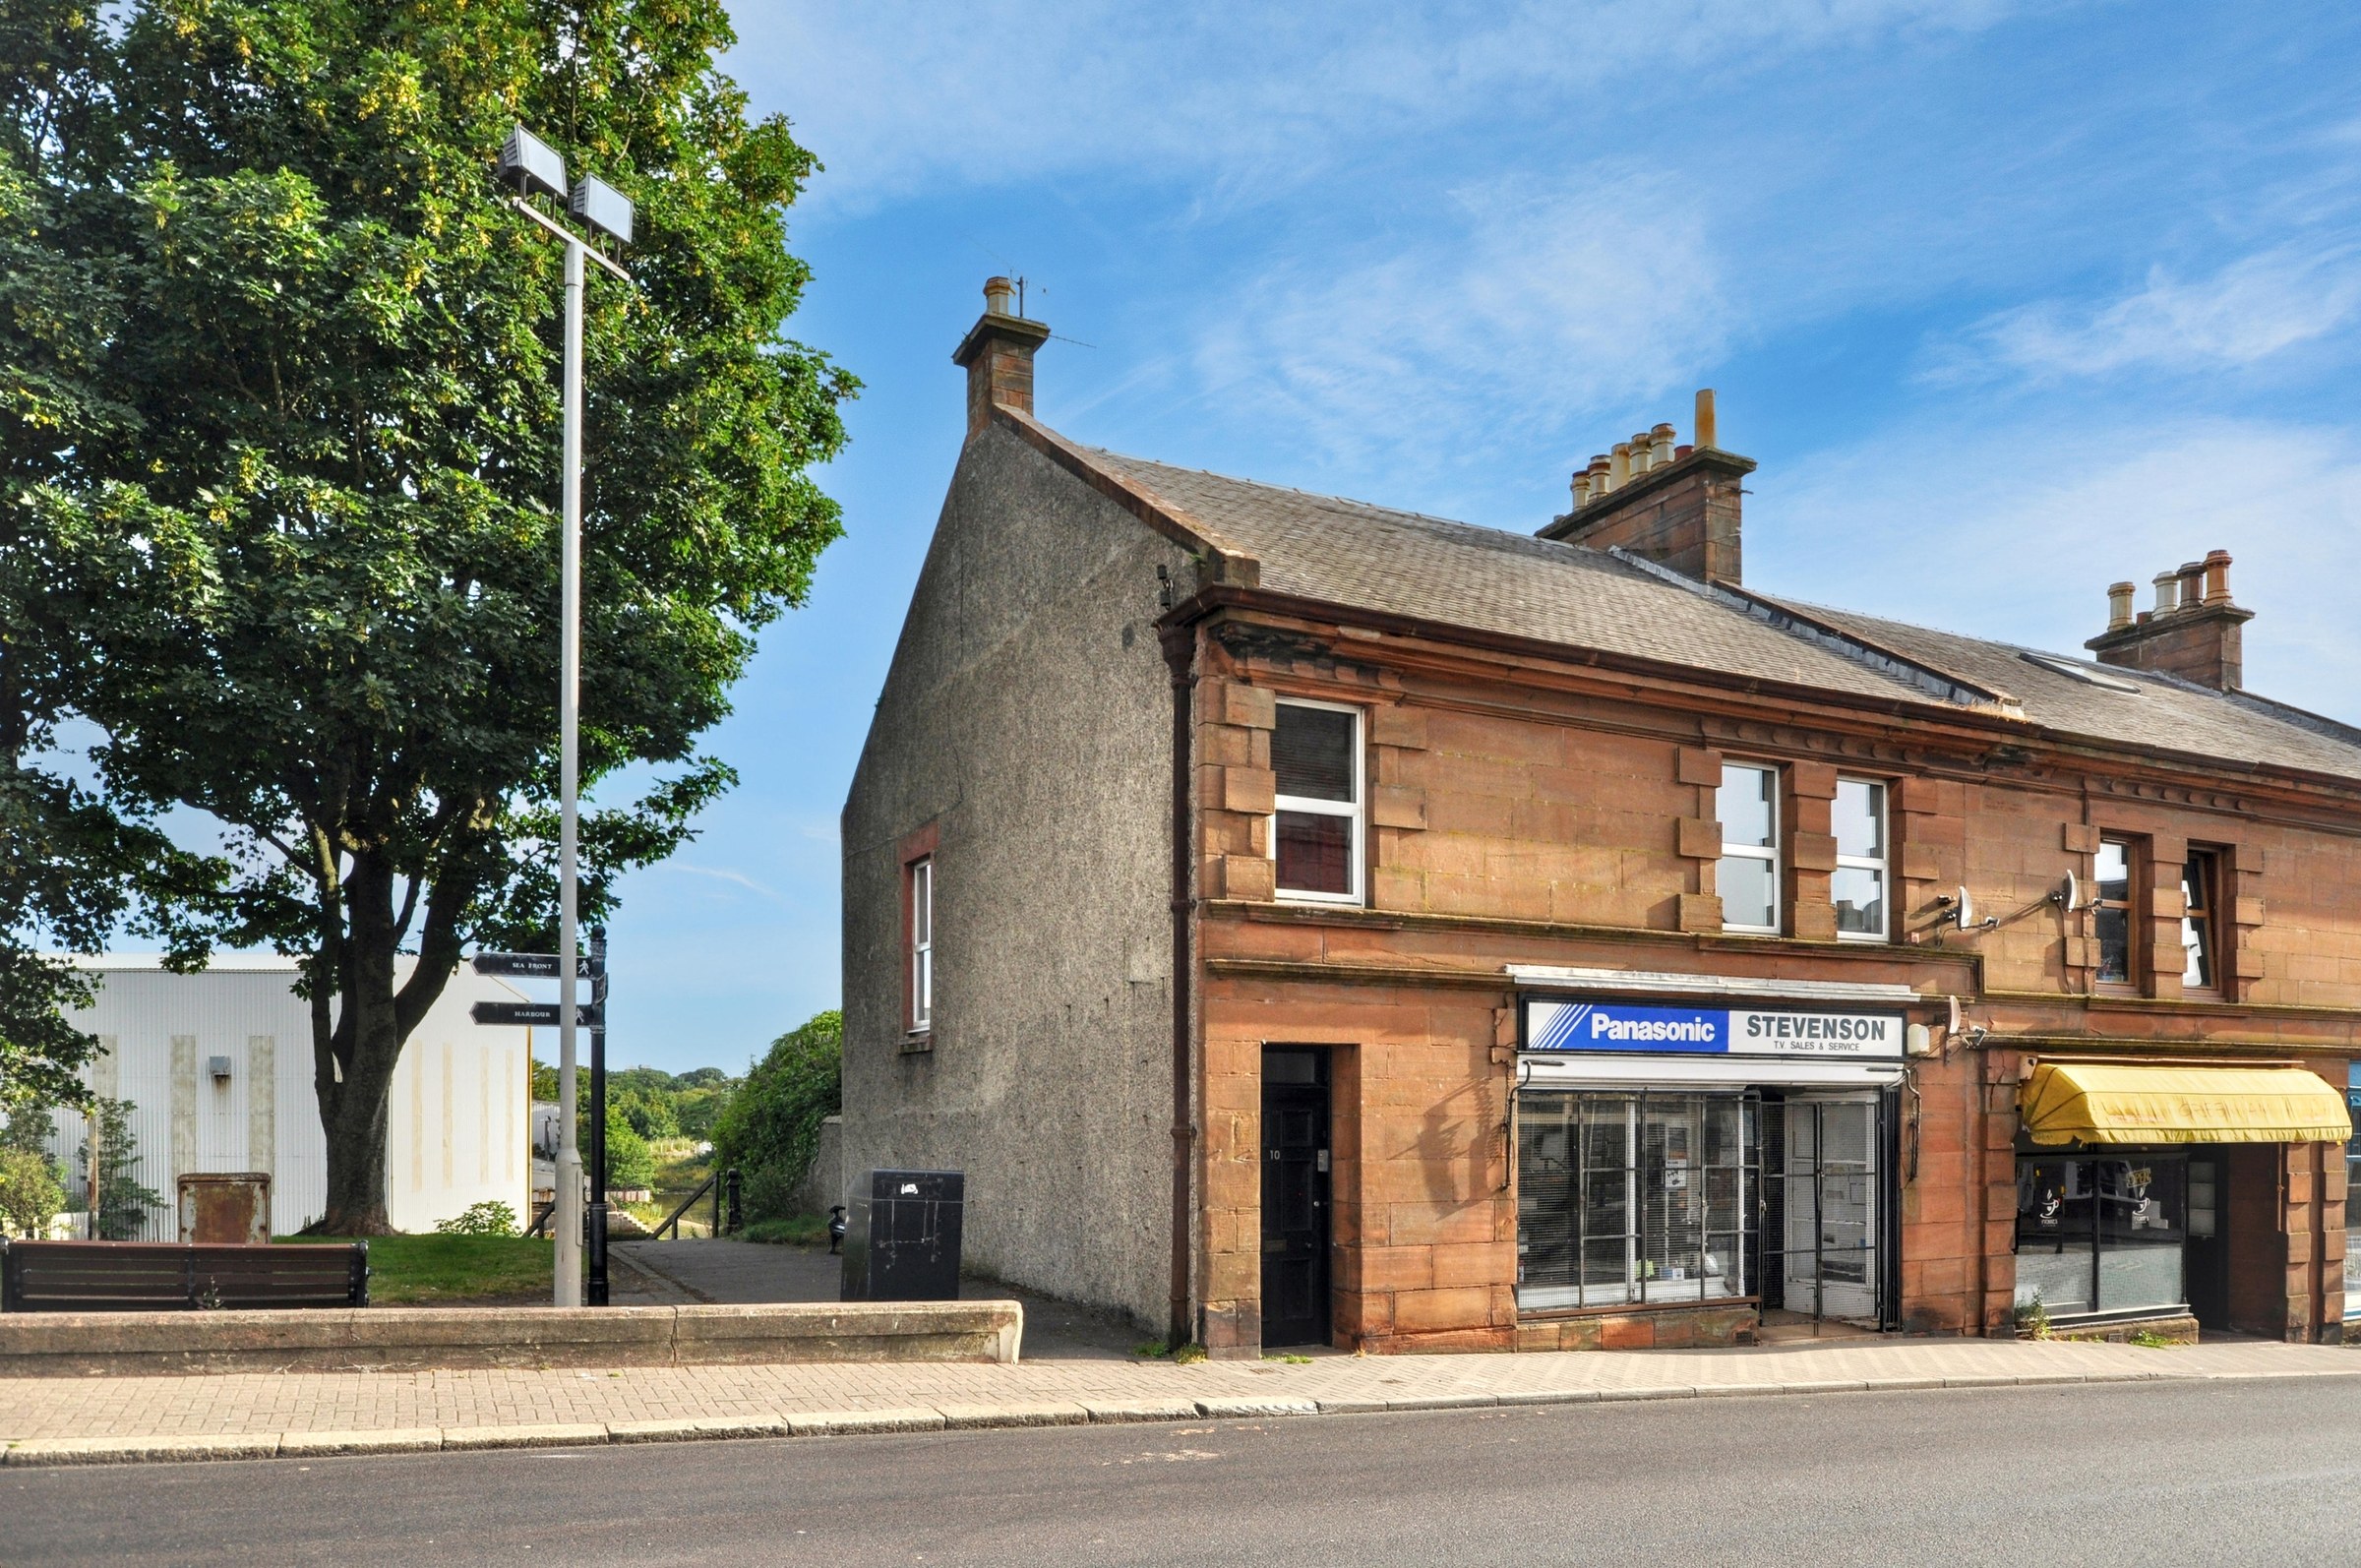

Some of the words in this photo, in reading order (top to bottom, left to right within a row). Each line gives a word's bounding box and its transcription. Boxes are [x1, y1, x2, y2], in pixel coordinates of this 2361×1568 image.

[1592, 1013, 1715, 1042] Panasonic
[1747, 1015, 1885, 1041] STEVENSON
[1828, 1043, 1860, 1052] SERVICE
[1270, 1150, 1280, 1160] 10
